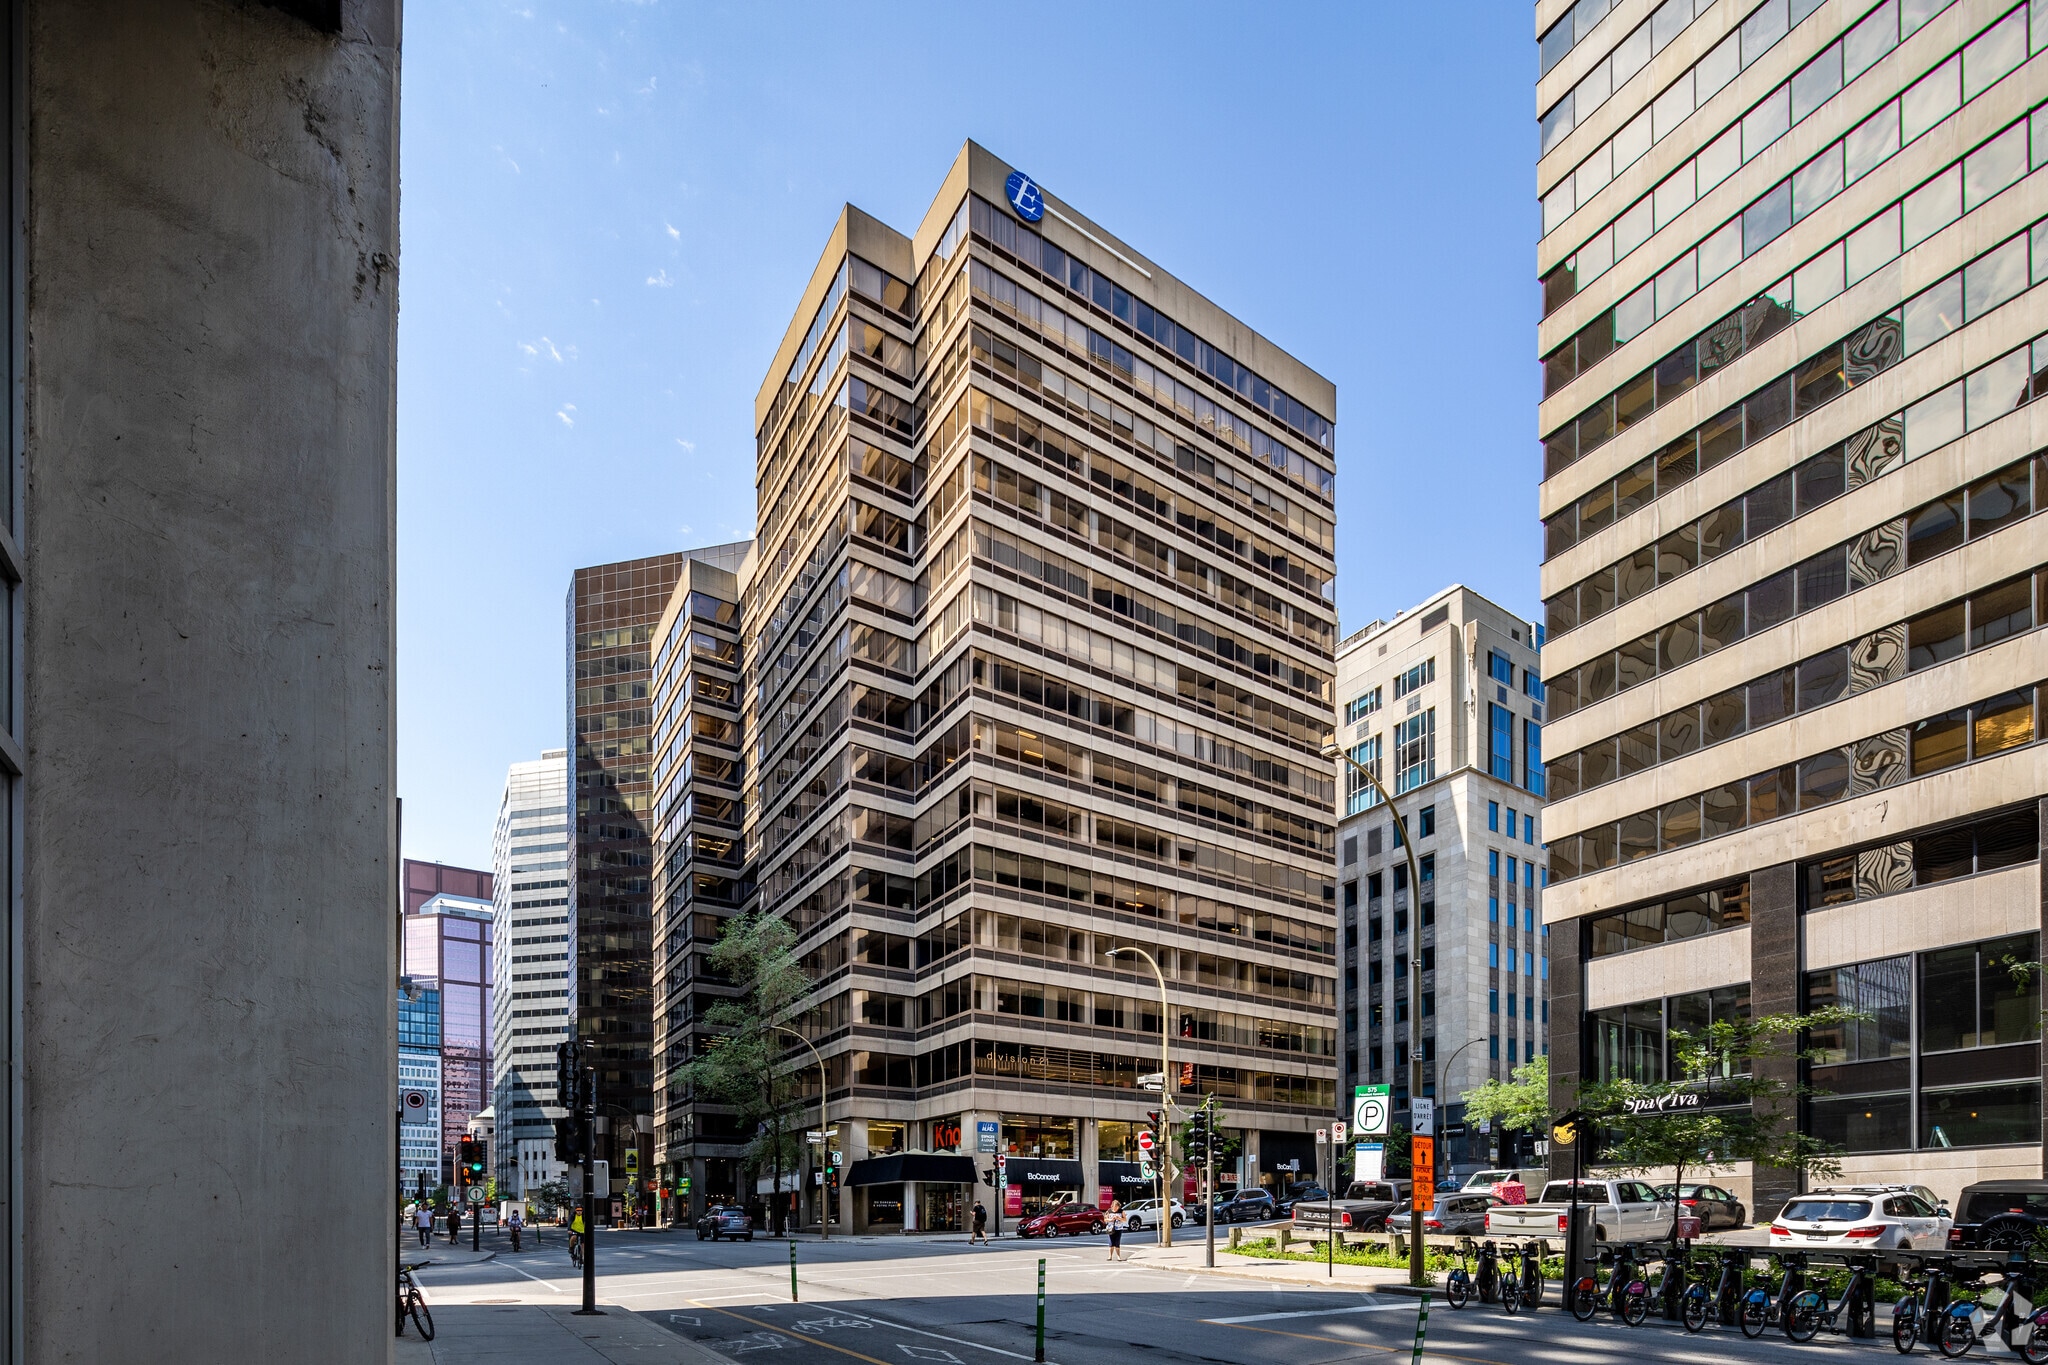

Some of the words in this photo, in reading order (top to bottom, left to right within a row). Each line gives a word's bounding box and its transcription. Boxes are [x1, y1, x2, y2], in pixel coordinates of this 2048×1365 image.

[986, 1051, 1036, 1064] dvision
[1415, 1102, 1430, 1110] LIGNE
[1364, 1106, 1379, 1126] P
[1027, 1172, 1060, 1182] BoConcept
